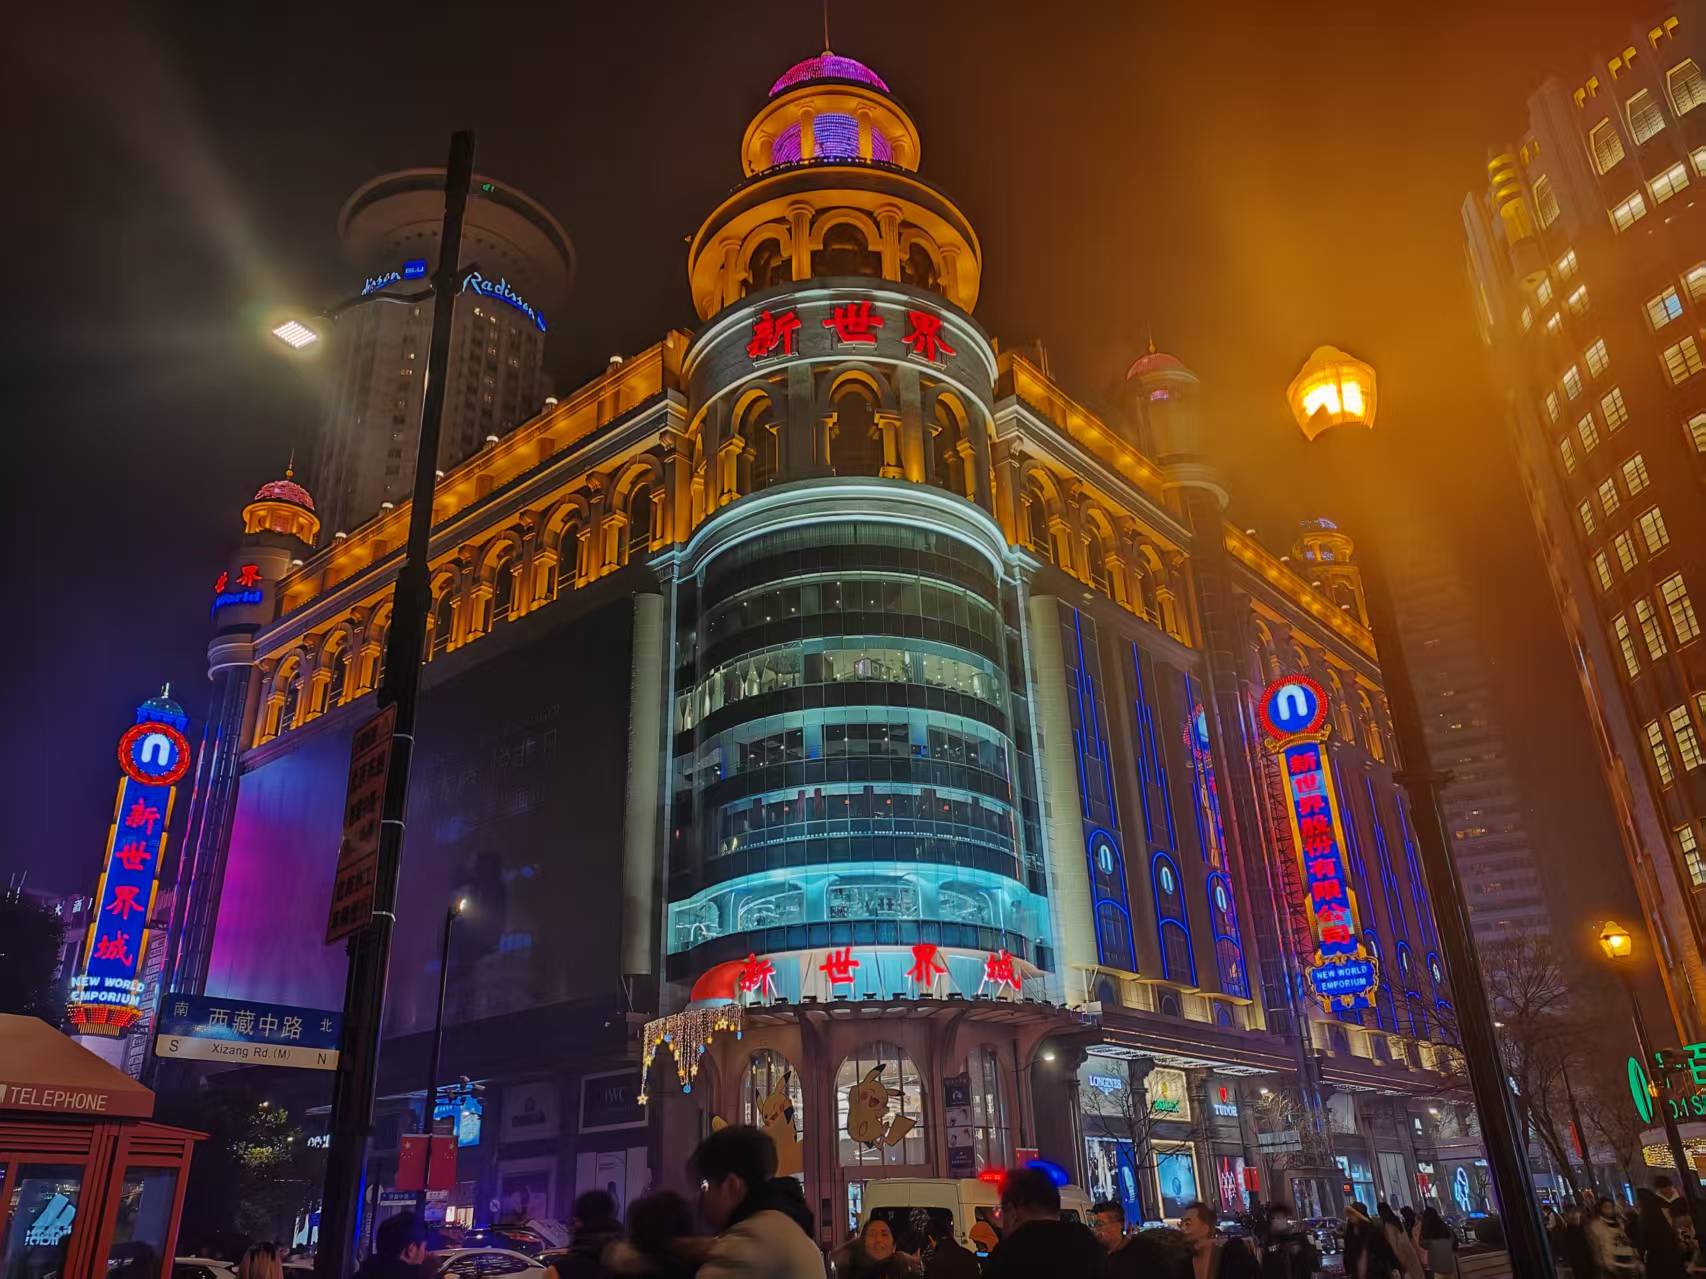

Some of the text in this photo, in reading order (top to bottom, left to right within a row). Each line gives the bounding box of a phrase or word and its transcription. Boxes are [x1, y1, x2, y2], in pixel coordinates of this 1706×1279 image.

[462, 271, 536, 321] Radisson
[747, 299, 958, 362] 新世界
[1288, 751, 1351, 946] 新世界股份有限公司
[94, 797, 161, 967] 新世界城
[739, 943, 1022, 998] 新世界城
[1316, 965, 1367, 980] NEW WORLD
[71, 976, 145, 992] NEW WORLD
[1321, 977, 1367, 991] EMPORIUM
[70, 990, 140, 1006] EMPORIUM
[174, 1001, 333, 1040] 南 西藏中路 北
[168, 1039, 180, 1053] S
[211, 1043, 249, 1059] Xizang
[253, 1047, 271, 1059] Rd.
[317, 1053, 327, 1065] N
[10, 1086, 109, 1112] TELEPHONE
[1213, 1103, 1238, 1117] TUDOR
